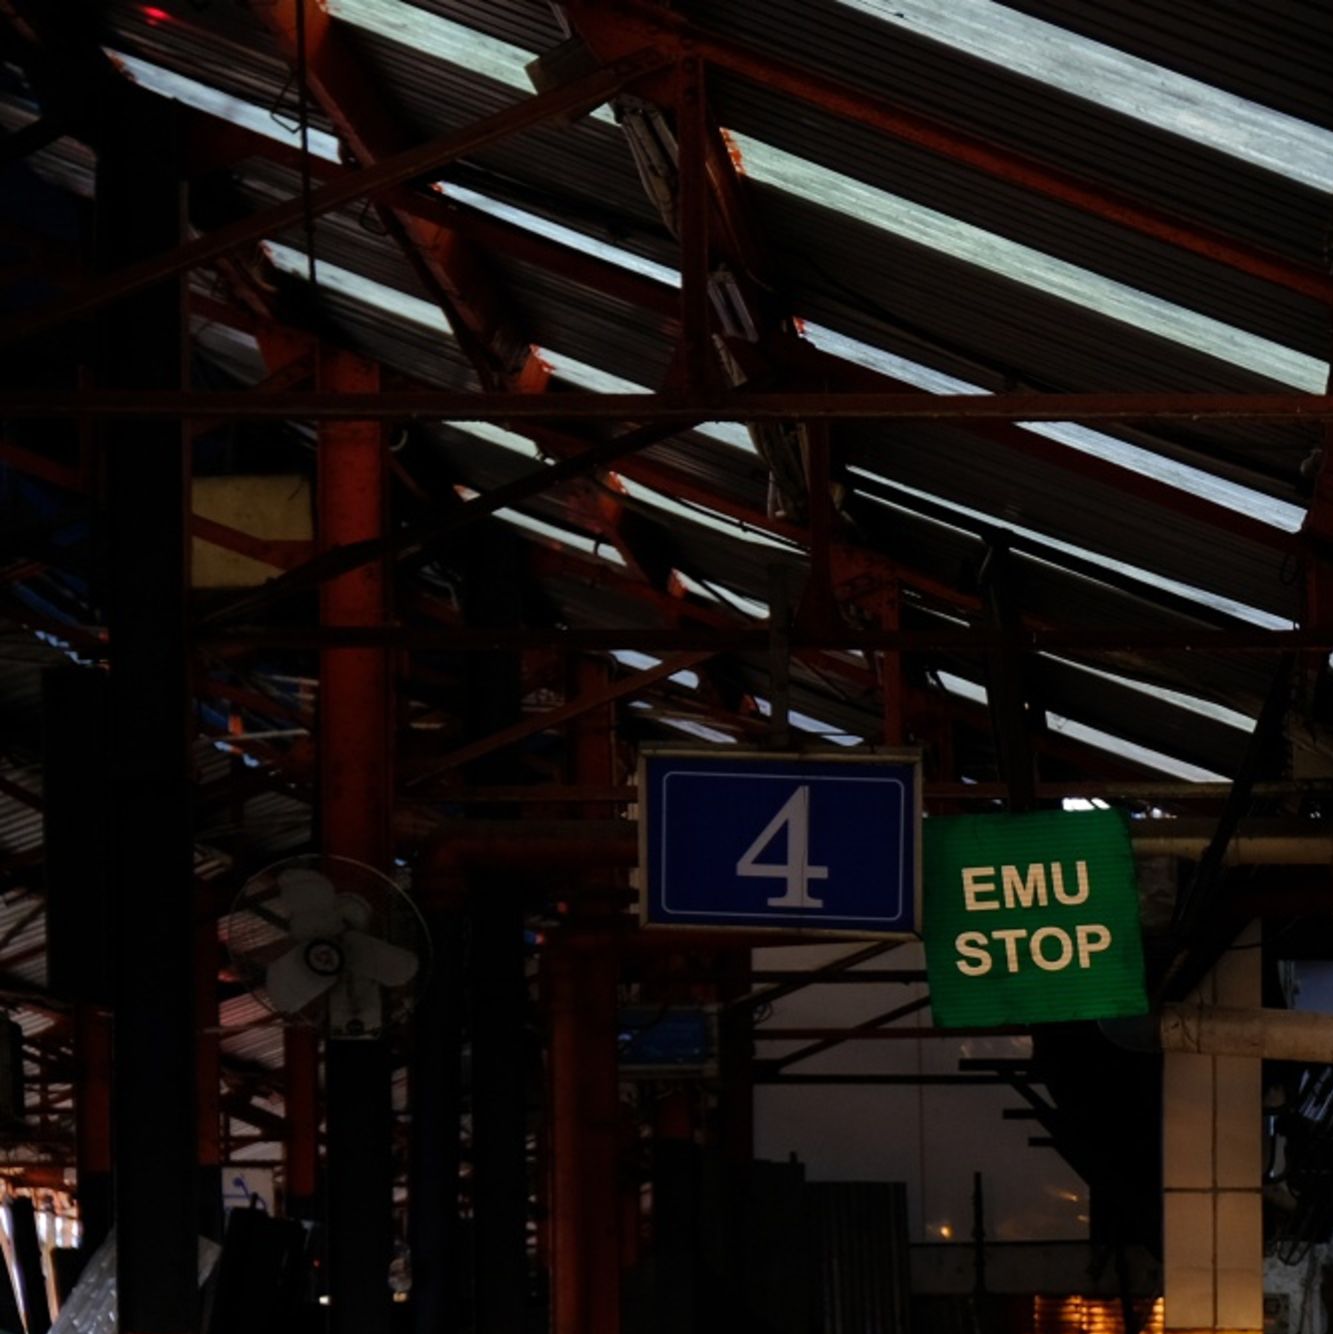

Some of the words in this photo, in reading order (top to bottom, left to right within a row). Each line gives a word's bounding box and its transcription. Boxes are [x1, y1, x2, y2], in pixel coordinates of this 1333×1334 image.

[735, 785, 829, 909] 4
[960, 860, 1090, 912] EMU
[954, 923, 1113, 977] STOP
